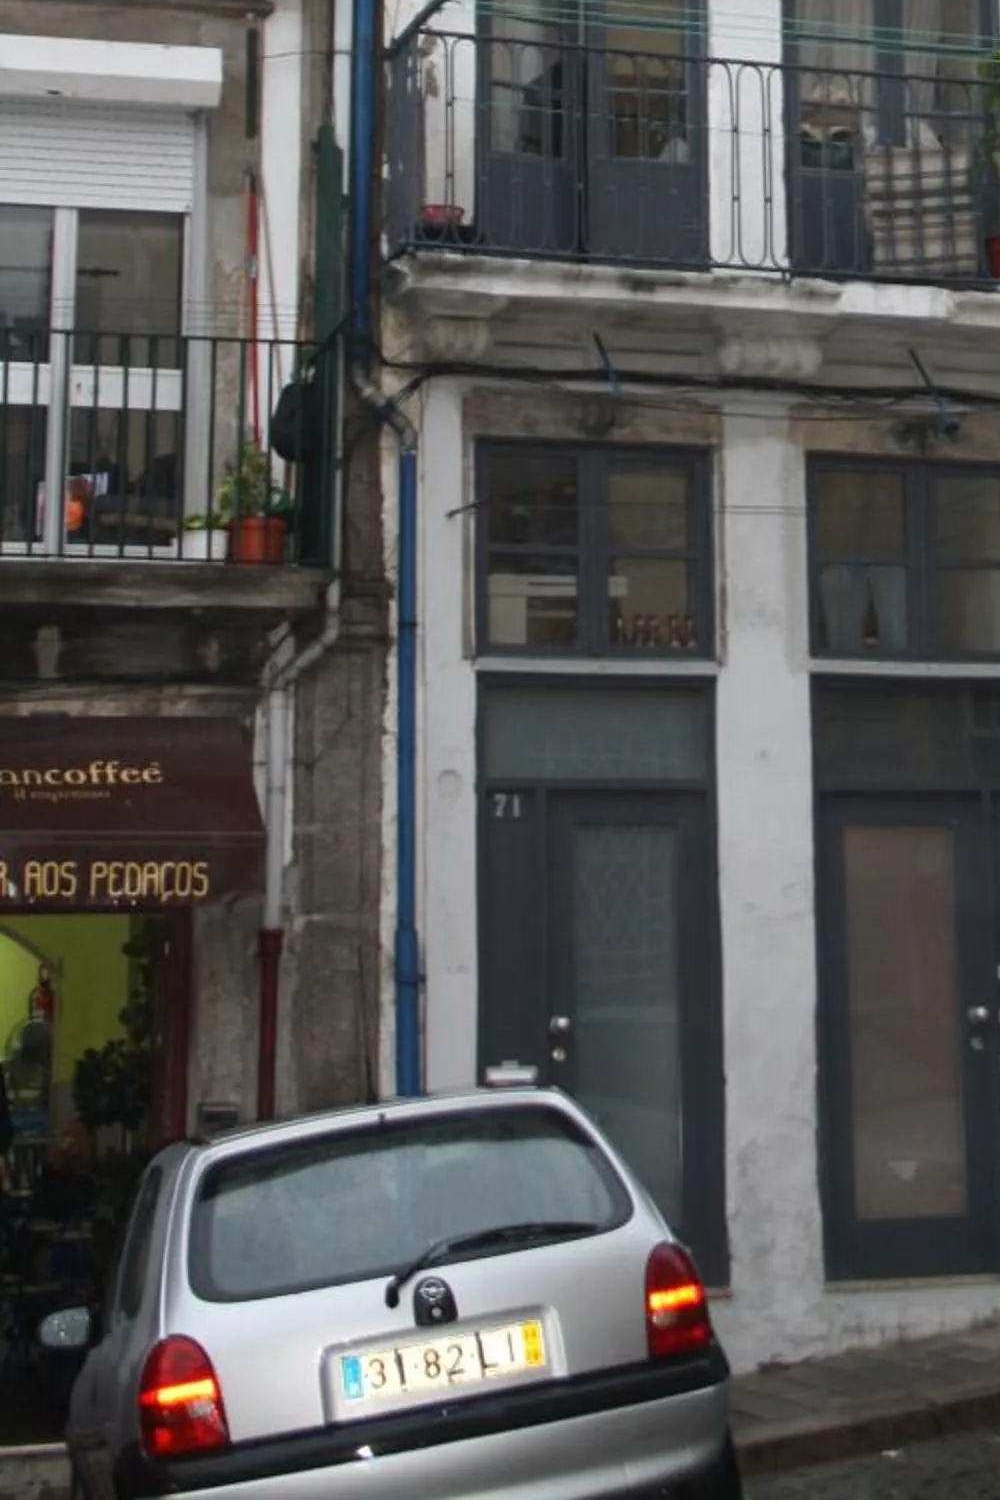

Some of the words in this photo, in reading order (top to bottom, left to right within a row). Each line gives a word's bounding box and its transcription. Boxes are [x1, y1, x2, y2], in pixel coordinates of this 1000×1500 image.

[494, 792, 520, 818] 71
[25, 861, 77, 897] AOS
[90, 861, 209, 901] PEDAÇOS
